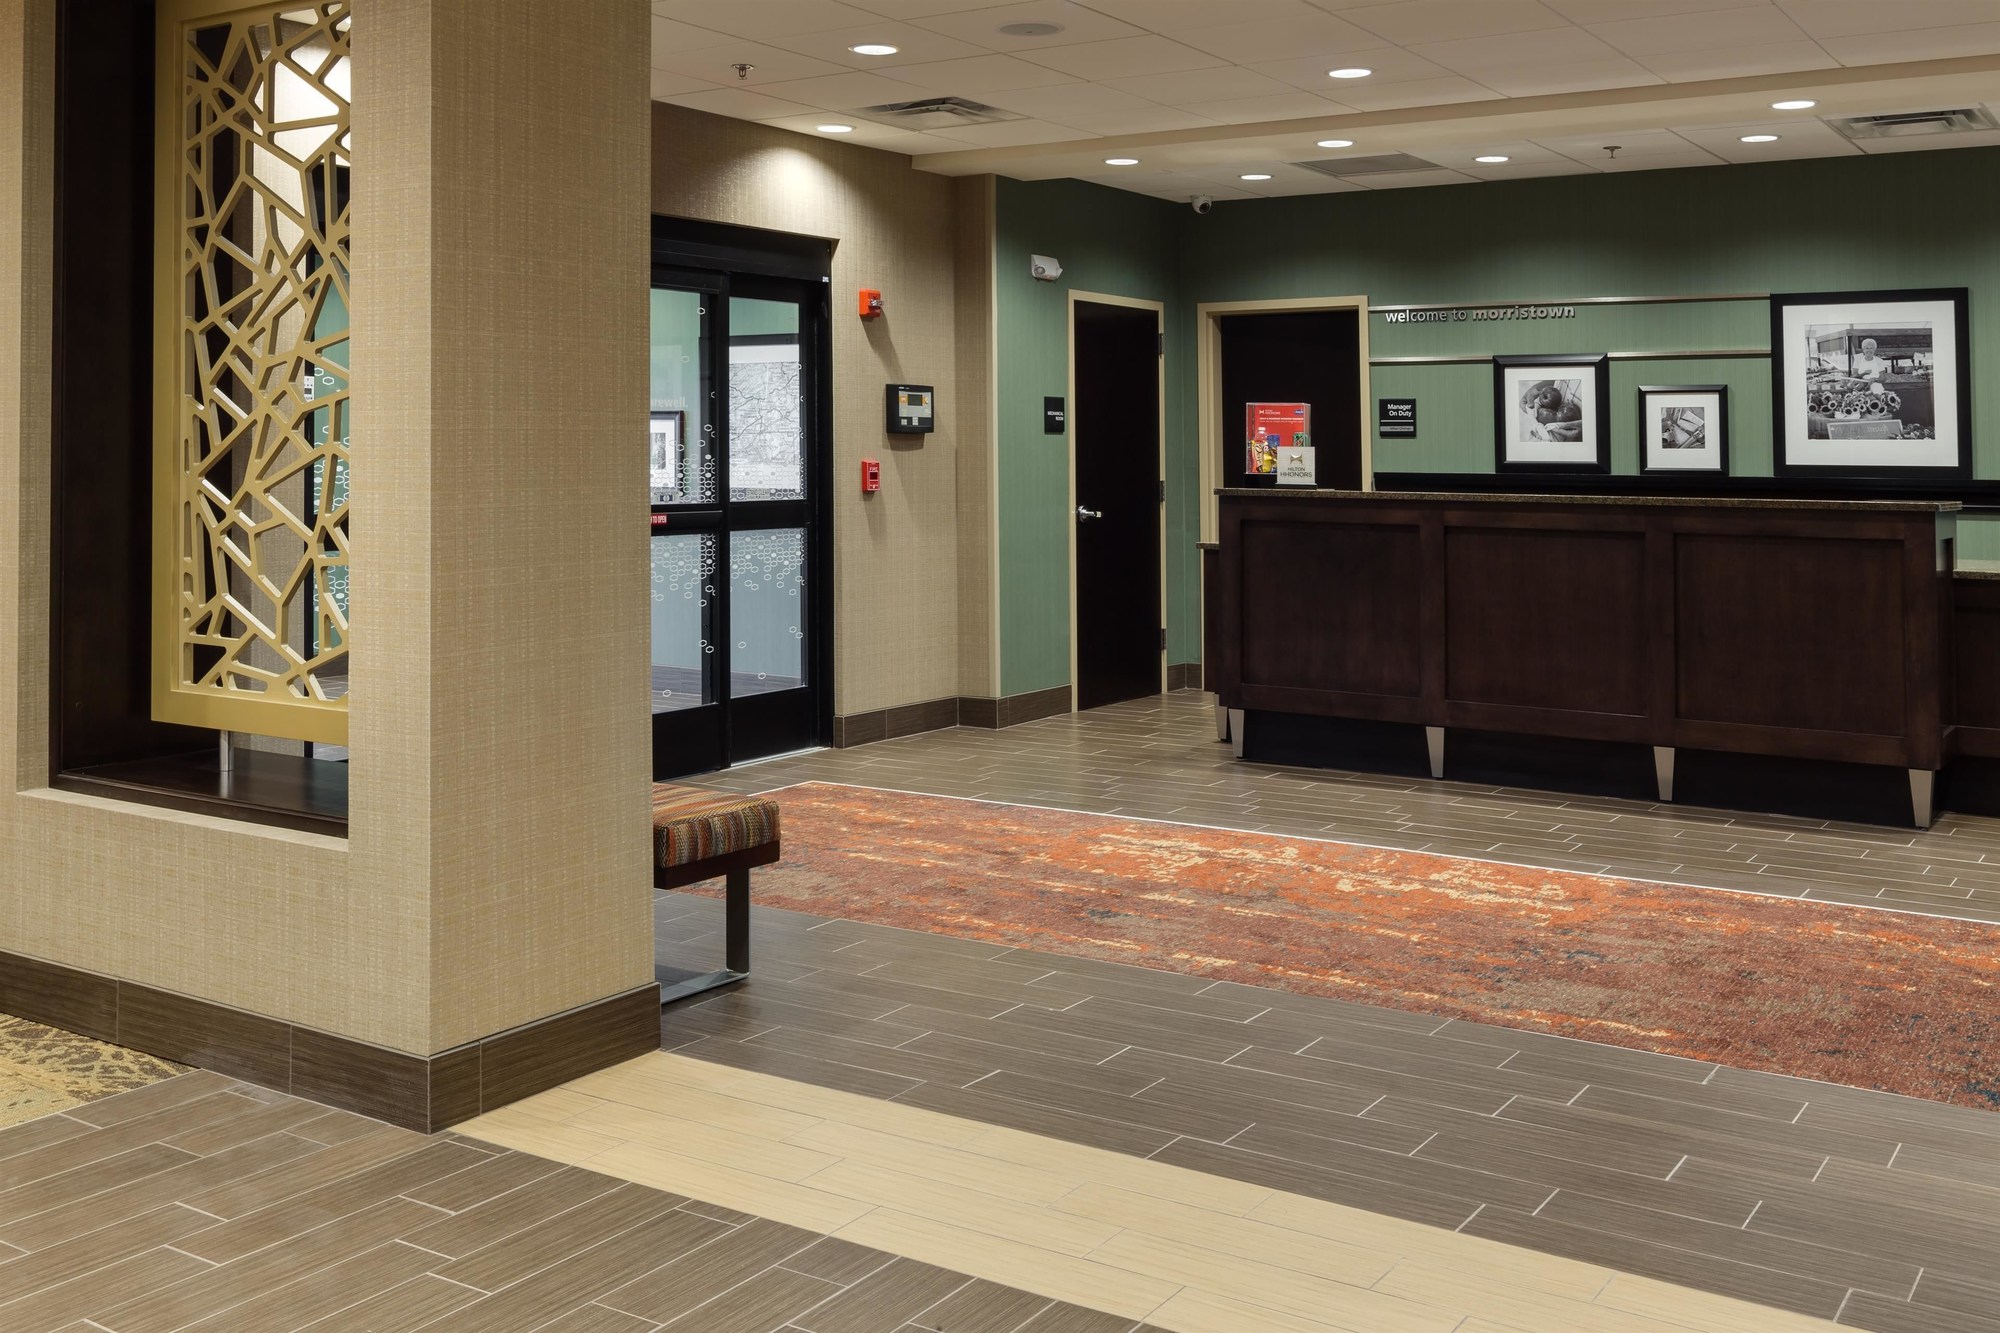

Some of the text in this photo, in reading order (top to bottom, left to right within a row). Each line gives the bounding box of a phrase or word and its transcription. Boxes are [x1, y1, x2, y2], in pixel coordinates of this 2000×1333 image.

[1385, 306, 1576, 322] welcome to morristown
[1398, 410, 1412, 418] Duty
[652, 515, 657, 524] TO
[657, 515, 667, 524] OPEN
